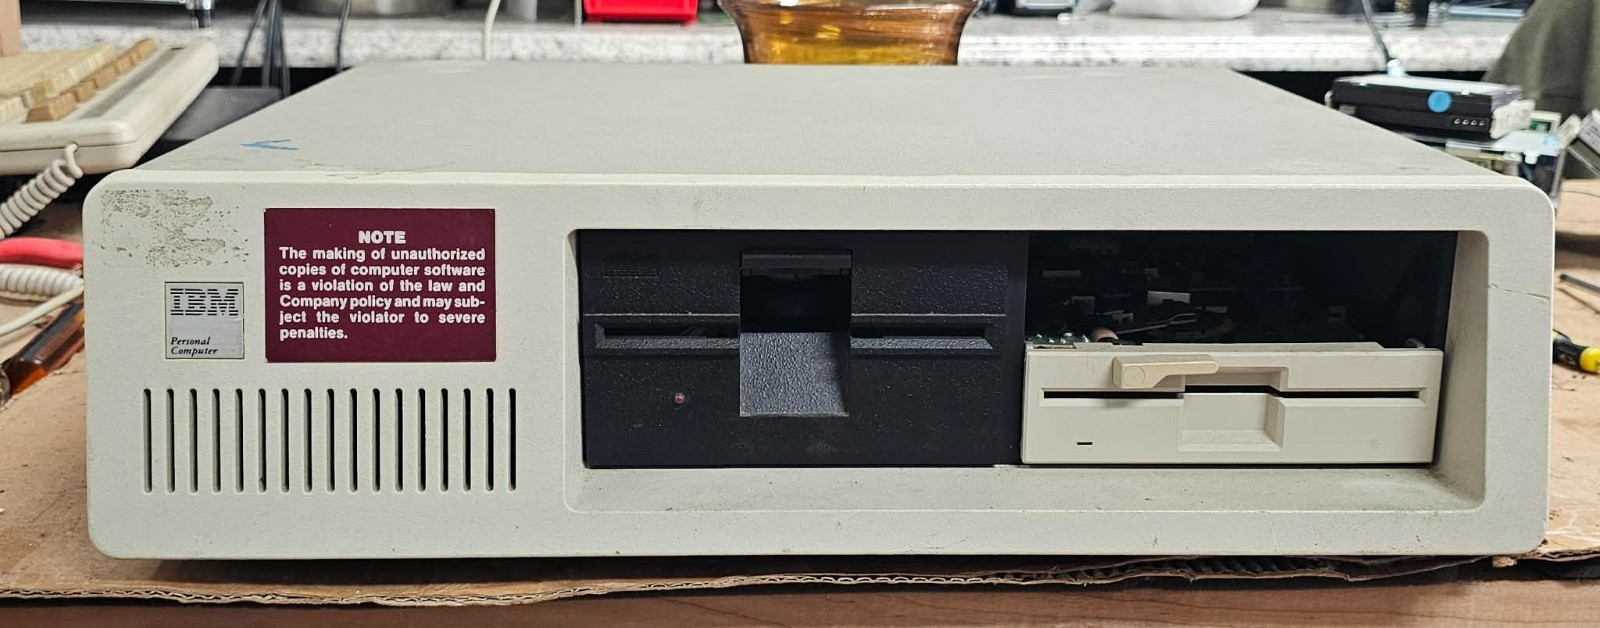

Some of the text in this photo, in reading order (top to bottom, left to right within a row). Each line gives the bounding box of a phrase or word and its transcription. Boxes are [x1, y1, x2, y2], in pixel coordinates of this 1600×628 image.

[359, 230, 406, 244] NOTE
[279, 247, 485, 262] The making of unauthorized
[279, 263, 485, 278] copies of computer software
[280, 279, 485, 292] is a violation of the law and
[170, 288, 239, 316] IBM
[280, 294, 485, 310] Company policy and may sub-
[279, 311, 485, 325] ject the violator to severe
[170, 336, 211, 346] Personal
[280, 327, 347, 341] penalties.
[170, 346, 219, 357] Computer
